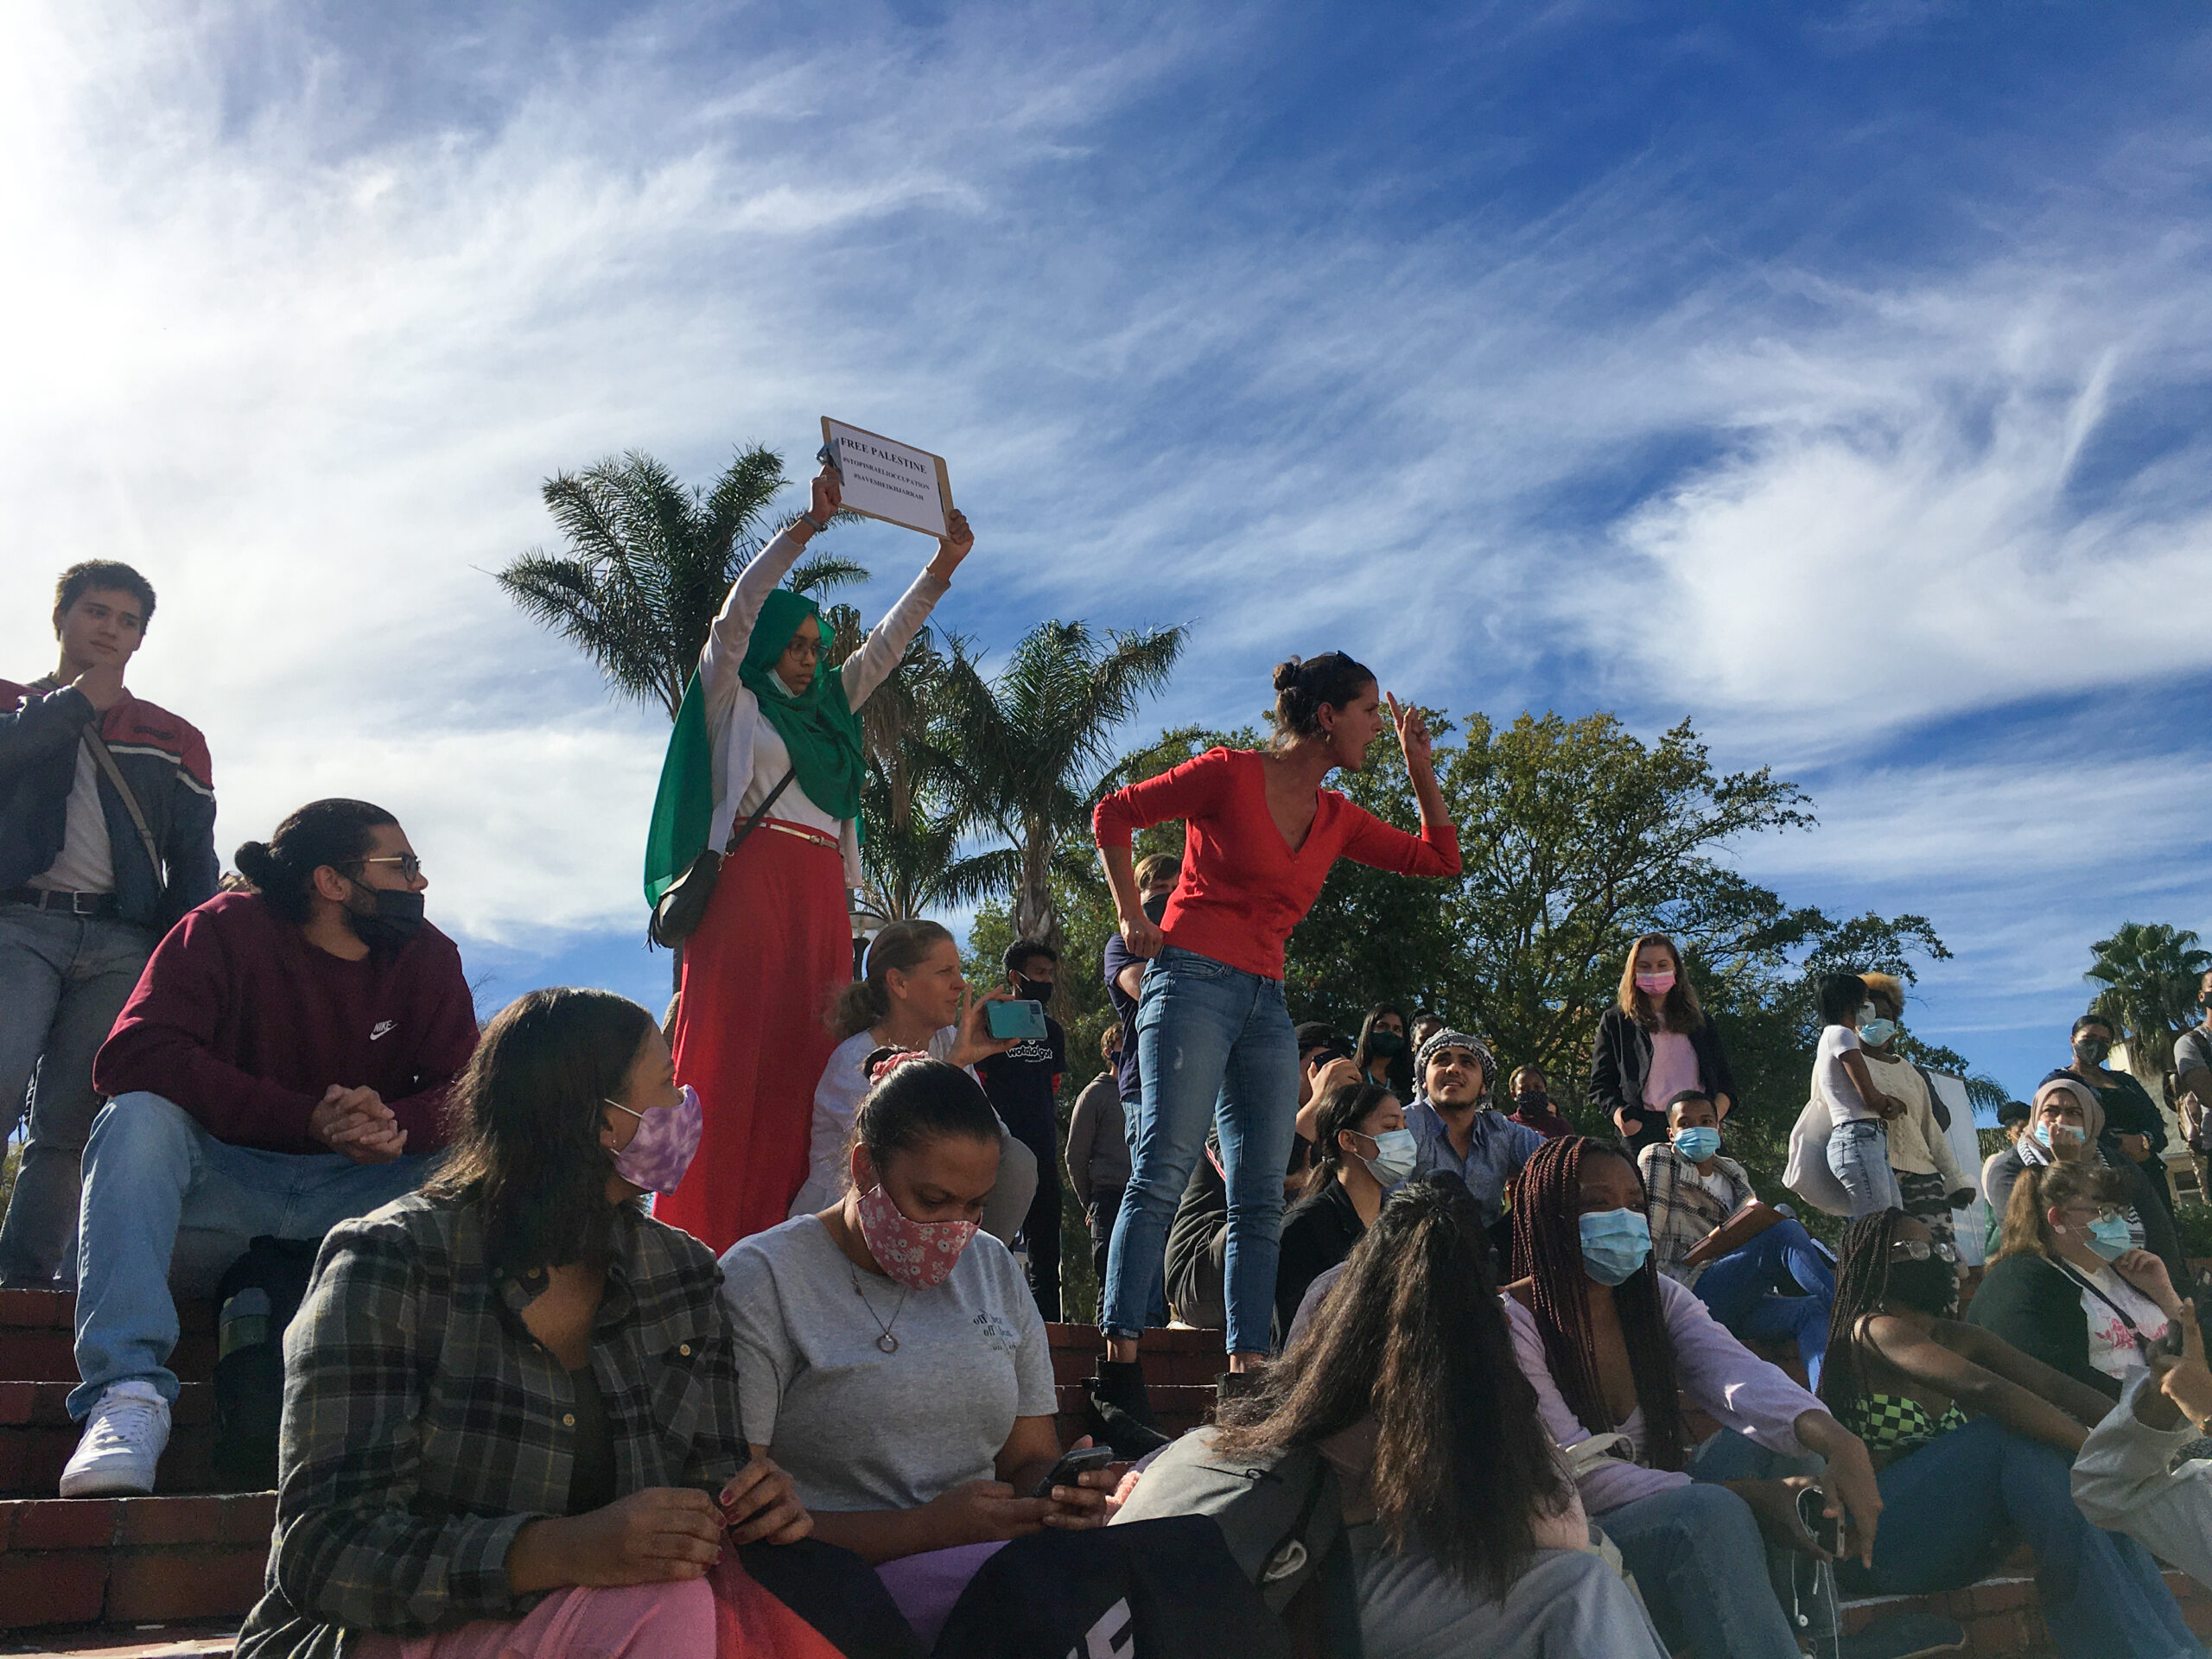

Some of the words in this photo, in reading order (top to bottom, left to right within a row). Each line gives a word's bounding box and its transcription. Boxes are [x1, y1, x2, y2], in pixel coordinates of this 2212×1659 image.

[841, 437, 869, 454] FREE
[871, 447, 927, 474] PALESTINE
[842, 456, 931, 491] #STOPISRAELIOCCUPATION
[373, 1020, 392, 1033] NIKE
